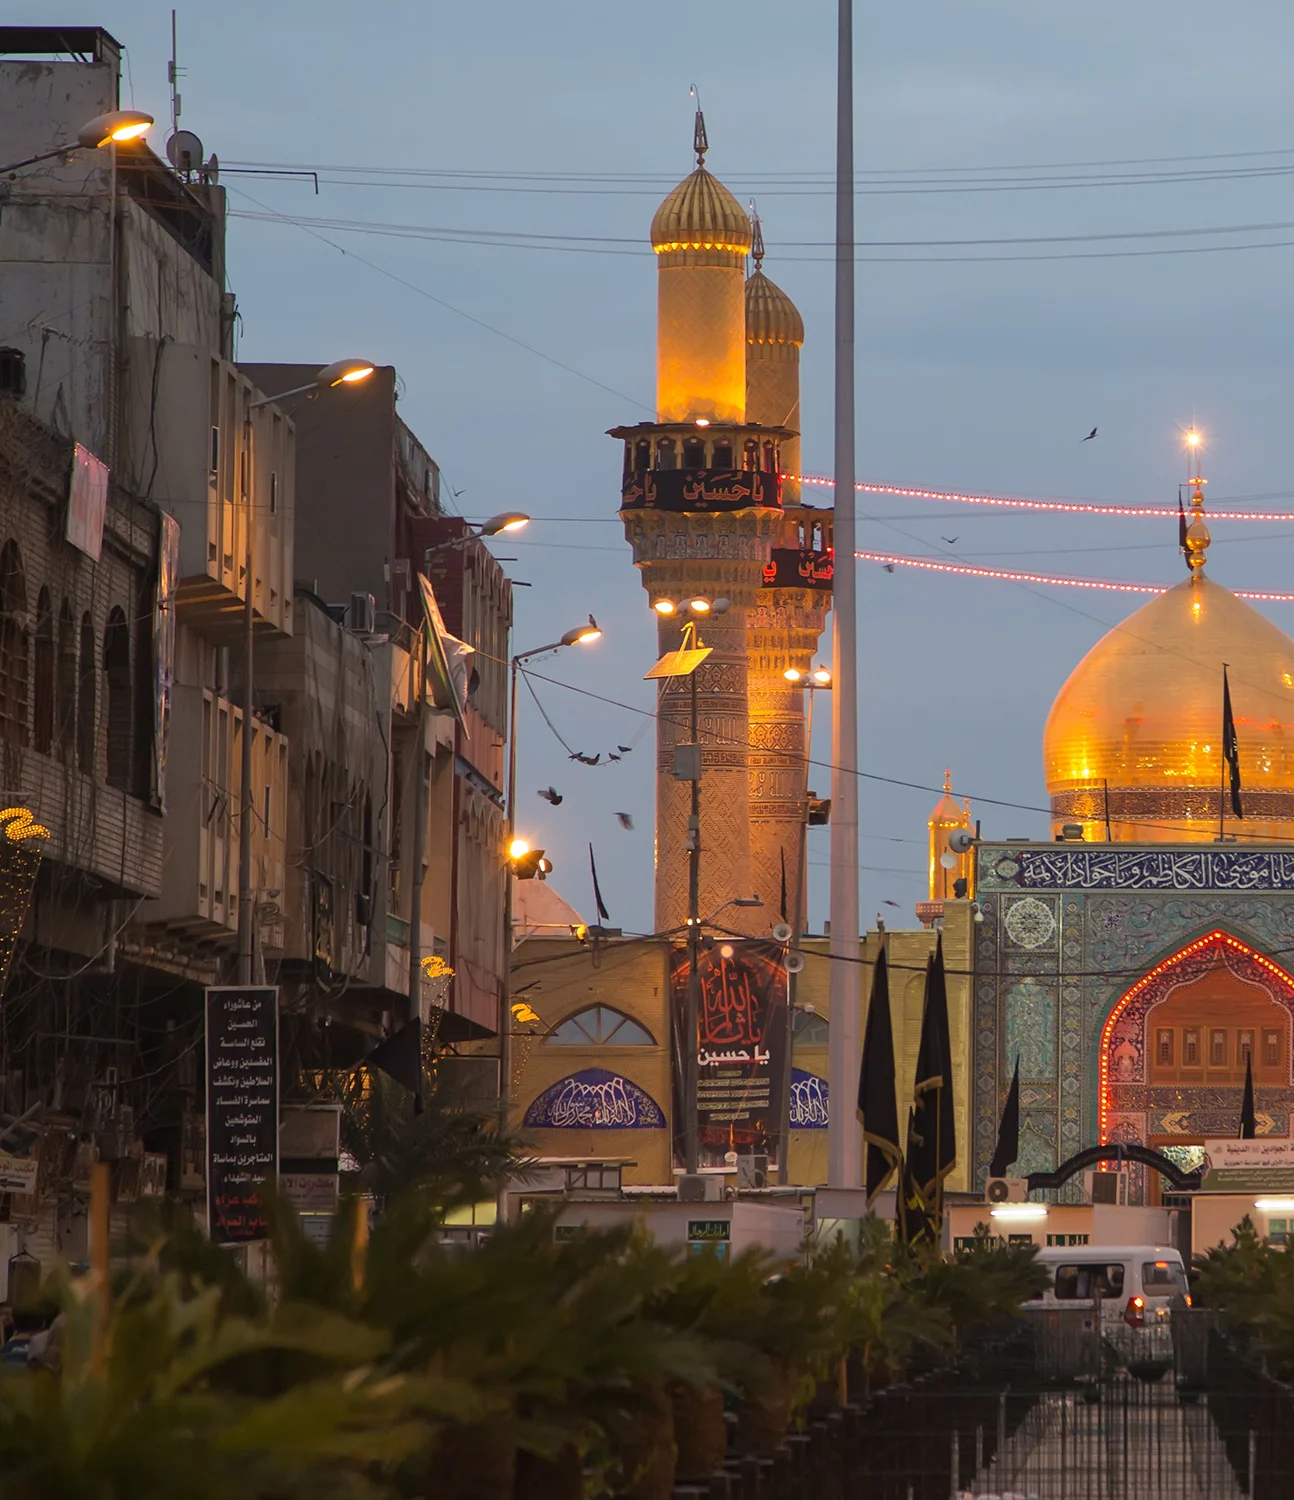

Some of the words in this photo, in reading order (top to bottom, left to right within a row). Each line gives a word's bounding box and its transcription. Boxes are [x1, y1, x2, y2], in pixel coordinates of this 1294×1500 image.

[227, 1019, 257, 1031] الحسين
[697, 1048, 750, 1066] حسين
[754, 1045, 770, 1066] يا
